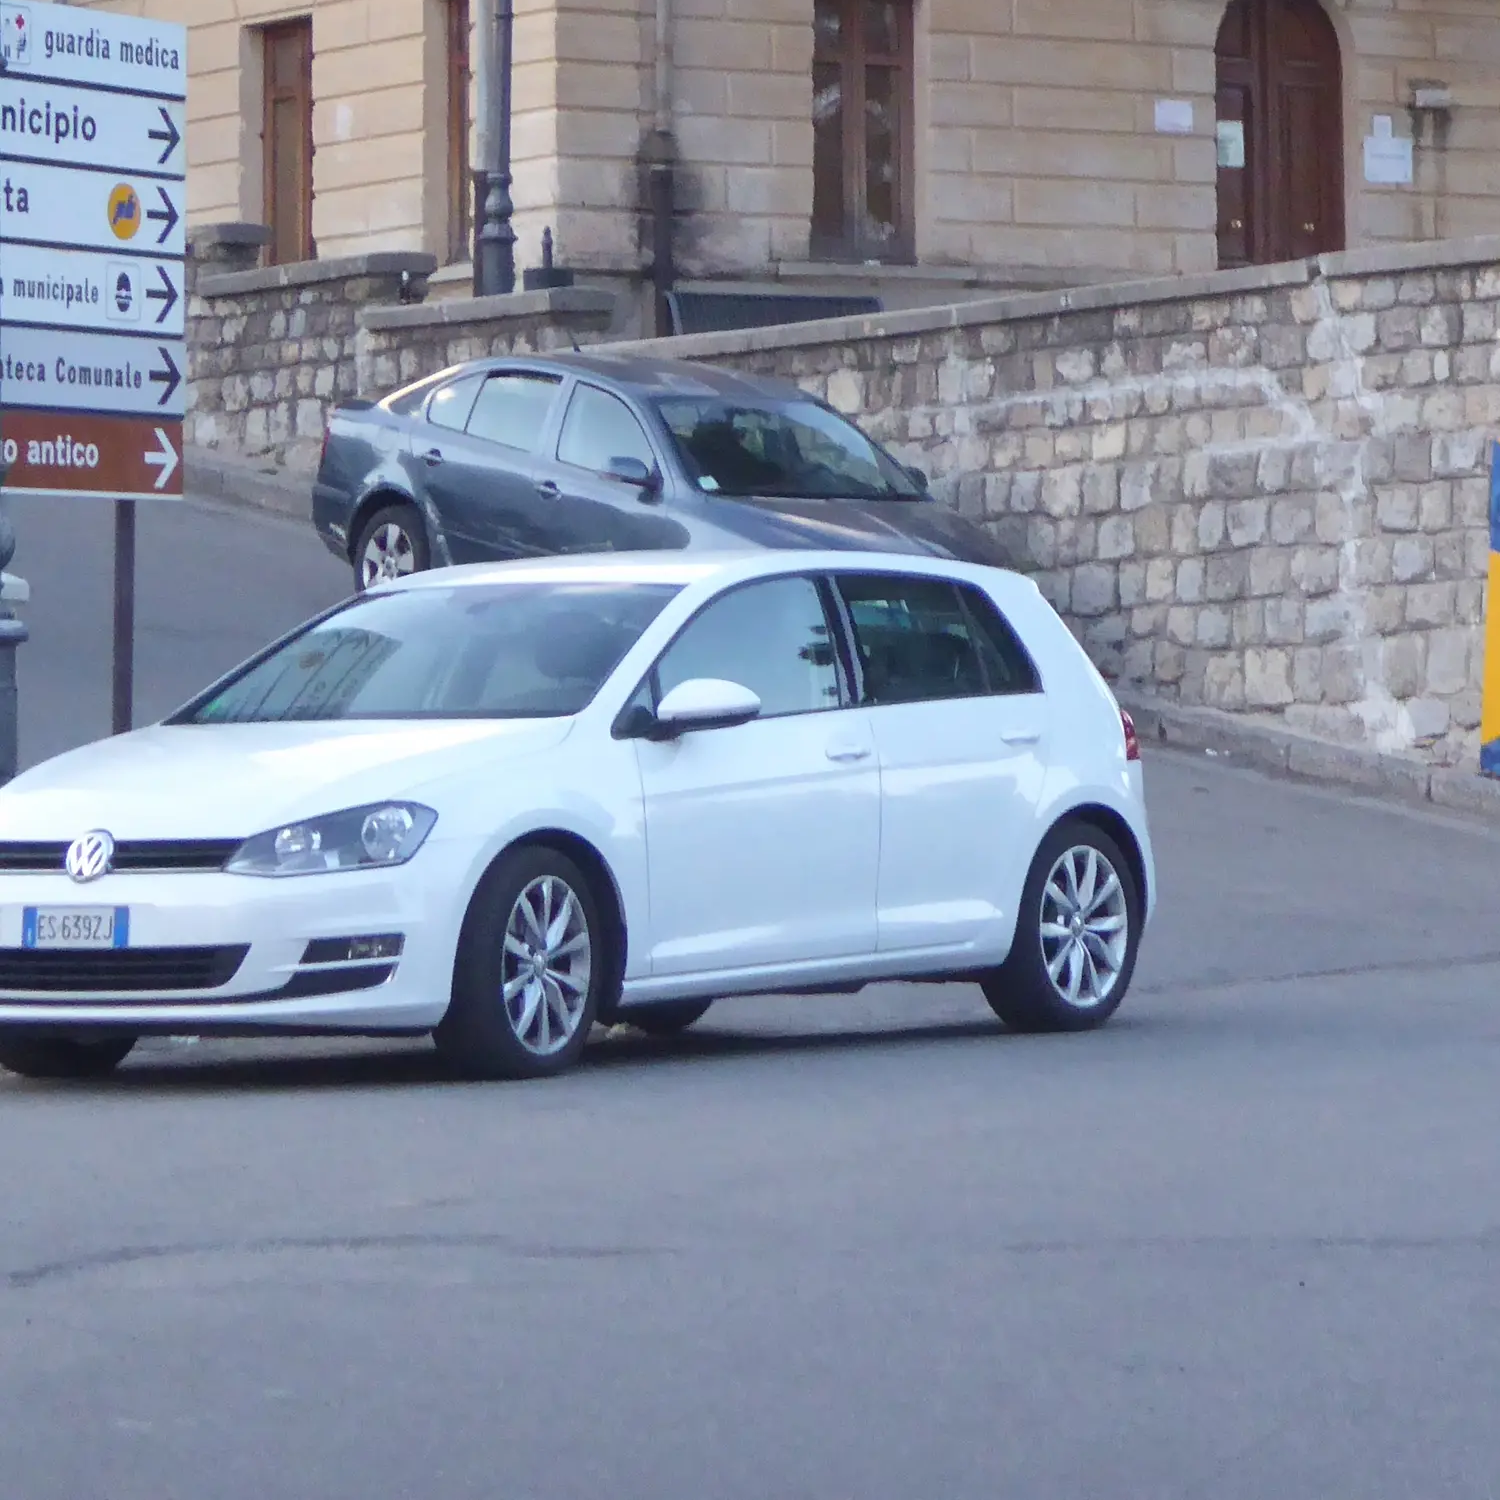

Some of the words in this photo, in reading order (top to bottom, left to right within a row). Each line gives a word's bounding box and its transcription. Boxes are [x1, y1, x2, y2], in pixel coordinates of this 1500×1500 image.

[44, 27, 111, 59] guardia
[119, 37, 179, 70] medica
[1, 97, 97, 145] nicipio
[3, 177, 30, 214] ta
[13, 275, 99, 309] municipale
[0, 353, 46, 382] teca
[55, 356, 142, 389] Comunale
[27, 434, 100, 468] antico
[37, 915, 57, 941] ES
[61, 915, 113, 941] 639ZJ
